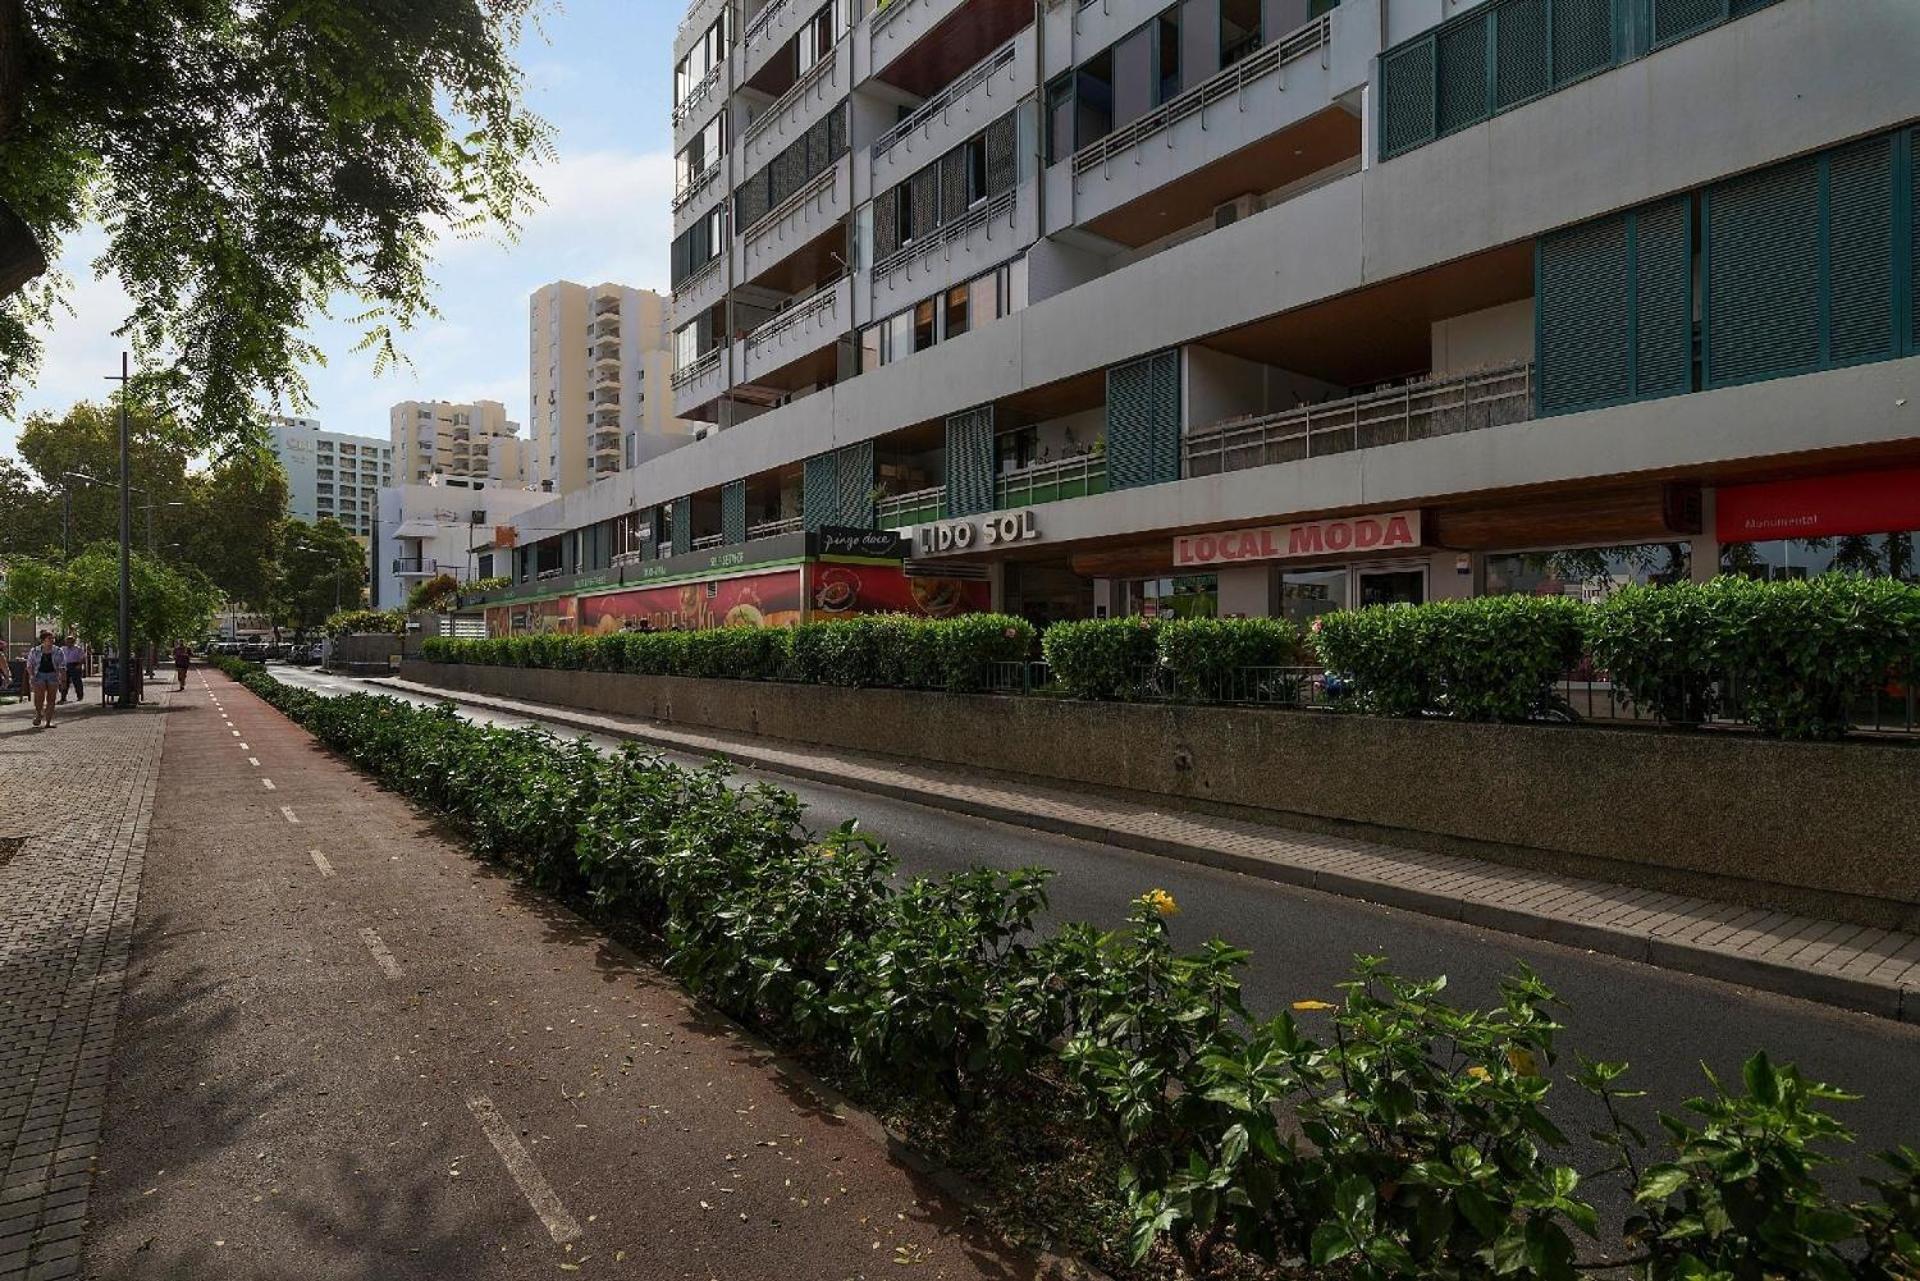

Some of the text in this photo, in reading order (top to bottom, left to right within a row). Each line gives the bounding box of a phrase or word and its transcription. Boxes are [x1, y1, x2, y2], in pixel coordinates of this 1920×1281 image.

[920, 511, 1036, 553] LIDO SOL
[1744, 515, 1818, 529] Monumental
[823, 532, 890, 553] pingo doce
[1180, 517, 1413, 563] LOCAL MODA
